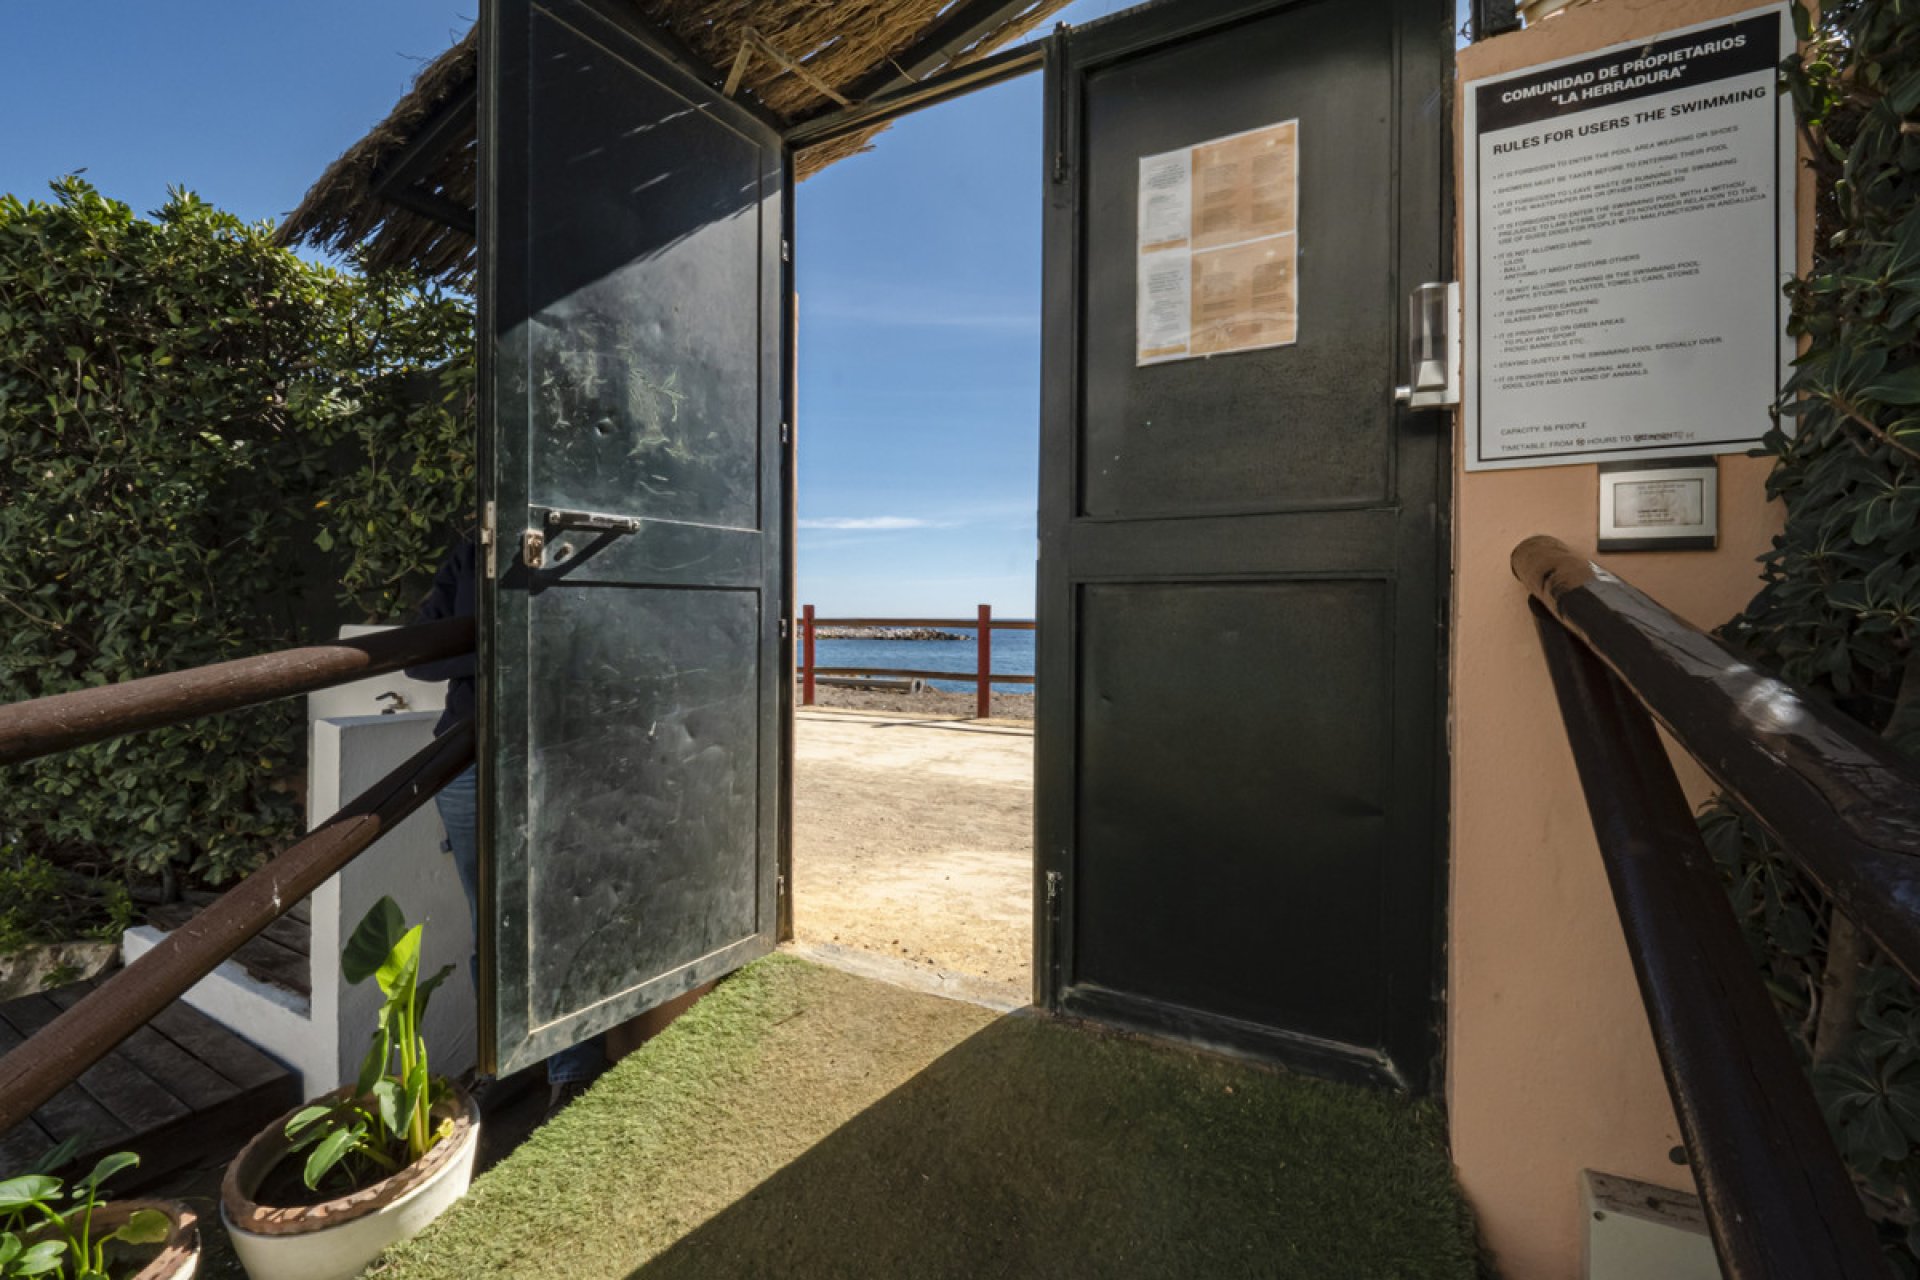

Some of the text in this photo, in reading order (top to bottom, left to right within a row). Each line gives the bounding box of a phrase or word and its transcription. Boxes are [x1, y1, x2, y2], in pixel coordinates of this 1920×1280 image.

[1501, 33, 1746, 104] COMUNIDAD DE PROPIETARIOS
[1551, 64, 1688, 106] "LA HERRADURA"
[1492, 85, 1768, 155] RULES FOR USERS THE SWIMMING
